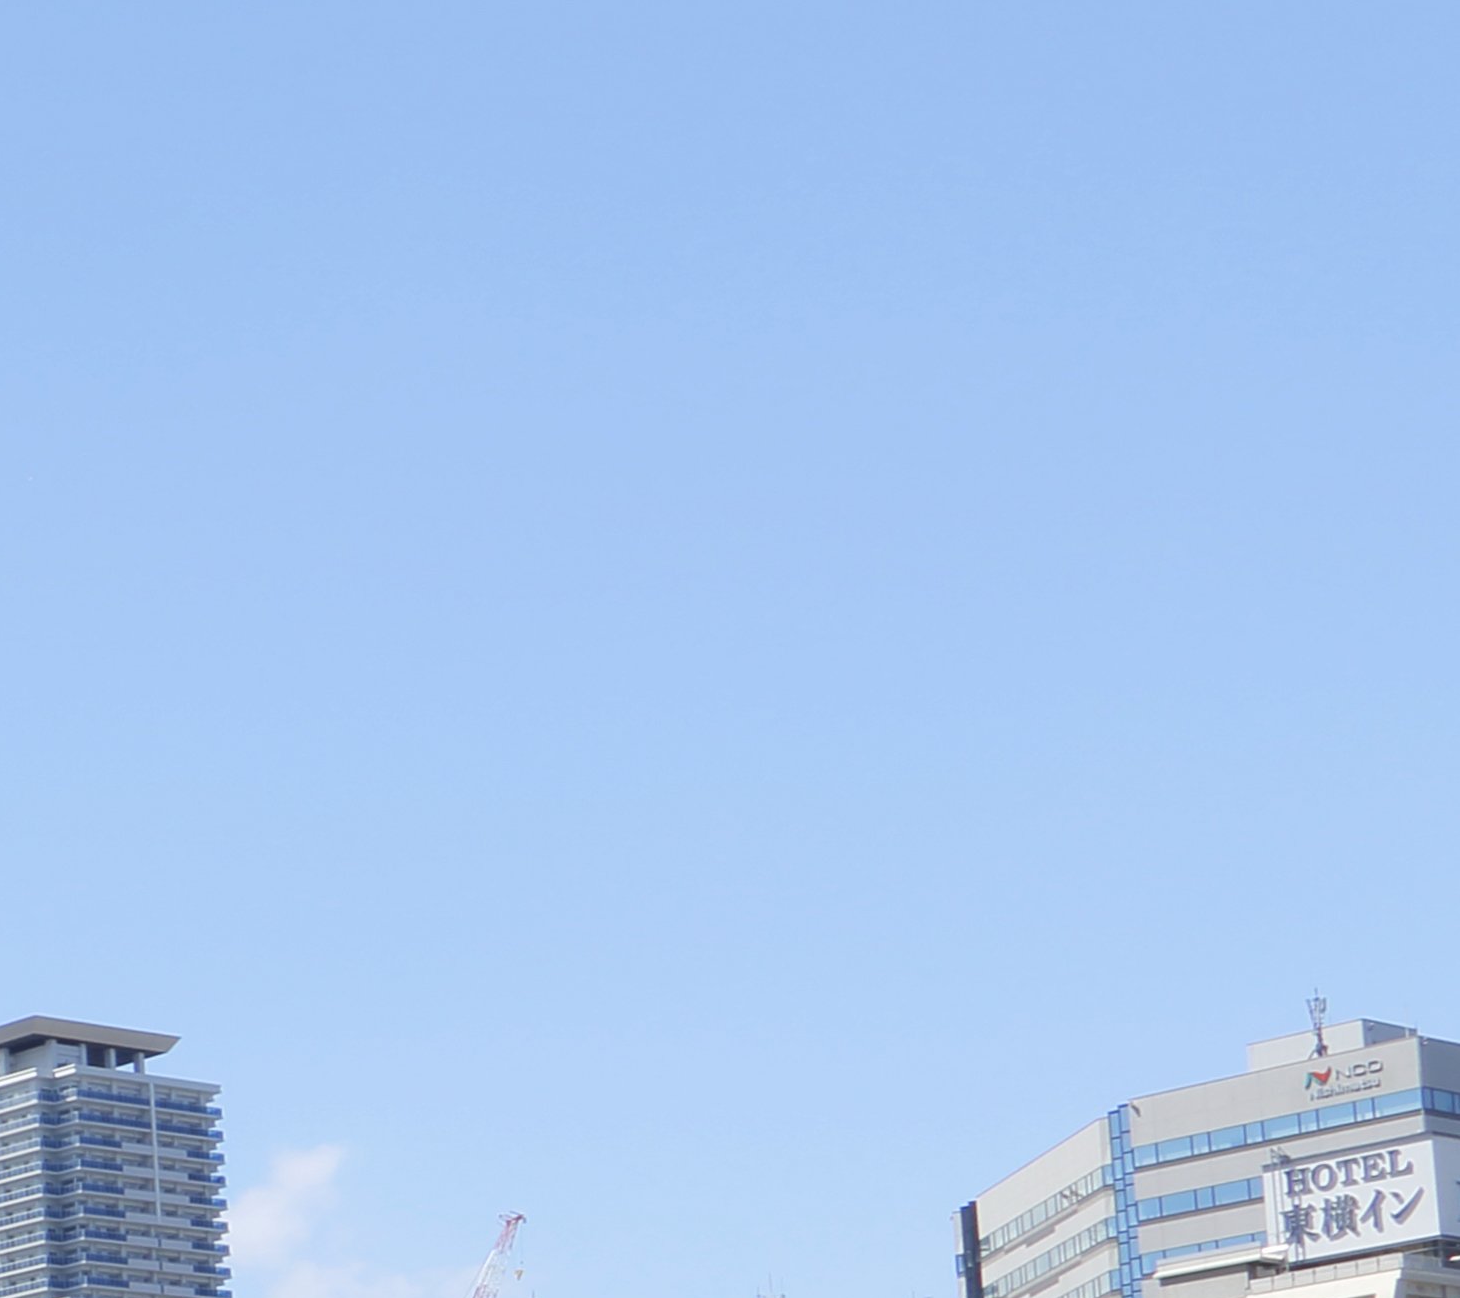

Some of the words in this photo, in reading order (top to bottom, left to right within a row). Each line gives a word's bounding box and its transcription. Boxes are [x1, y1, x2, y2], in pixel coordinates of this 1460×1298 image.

[1285, 1149, 1414, 1197] HOTEL
[1280, 1187, 1425, 1247] 東横イン
